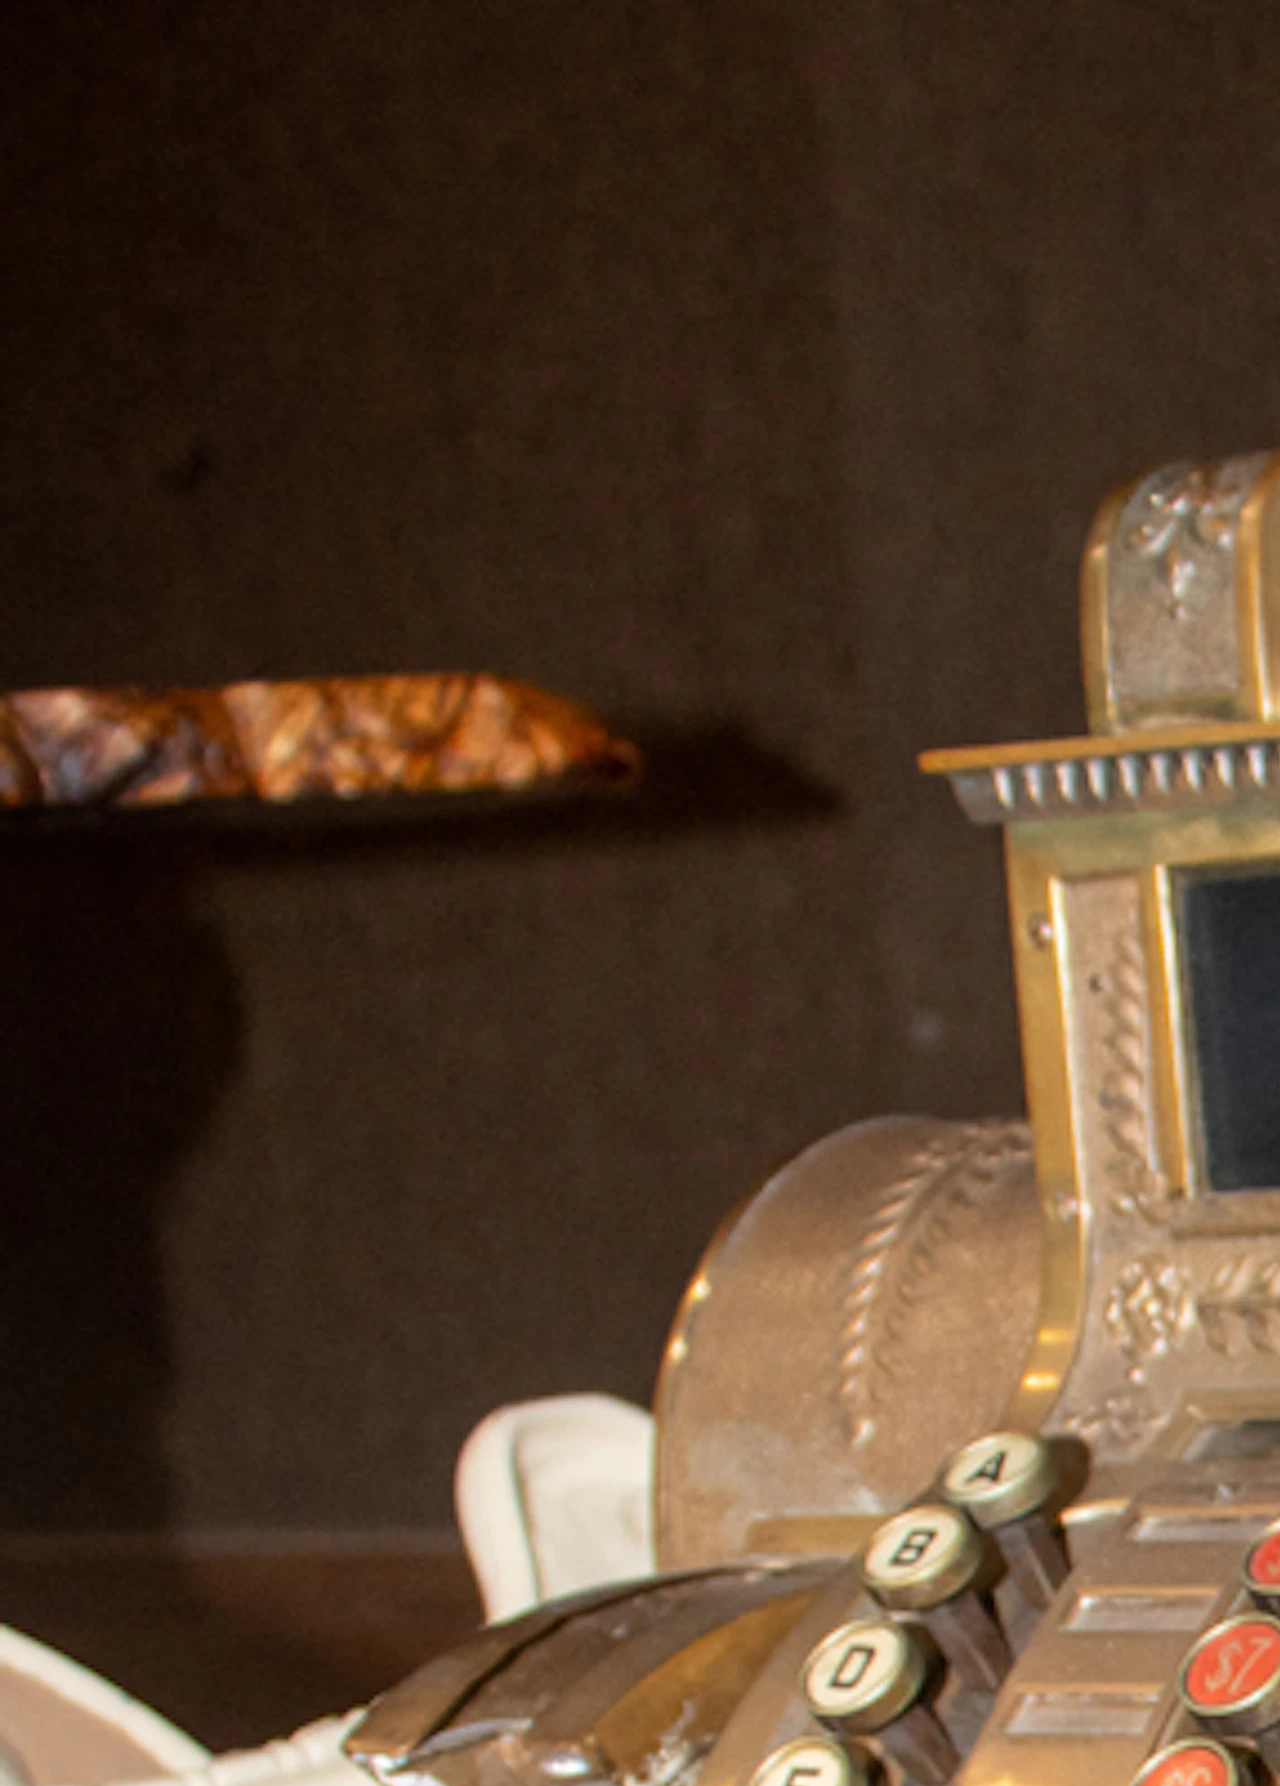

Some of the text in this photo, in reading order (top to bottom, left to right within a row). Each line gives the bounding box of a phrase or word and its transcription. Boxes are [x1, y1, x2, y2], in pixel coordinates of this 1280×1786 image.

[965, 1451, 1008, 1485] A
[890, 1528, 939, 1566] B
[829, 1644, 875, 1689] D
[1205, 1637, 1273, 1695] $7
